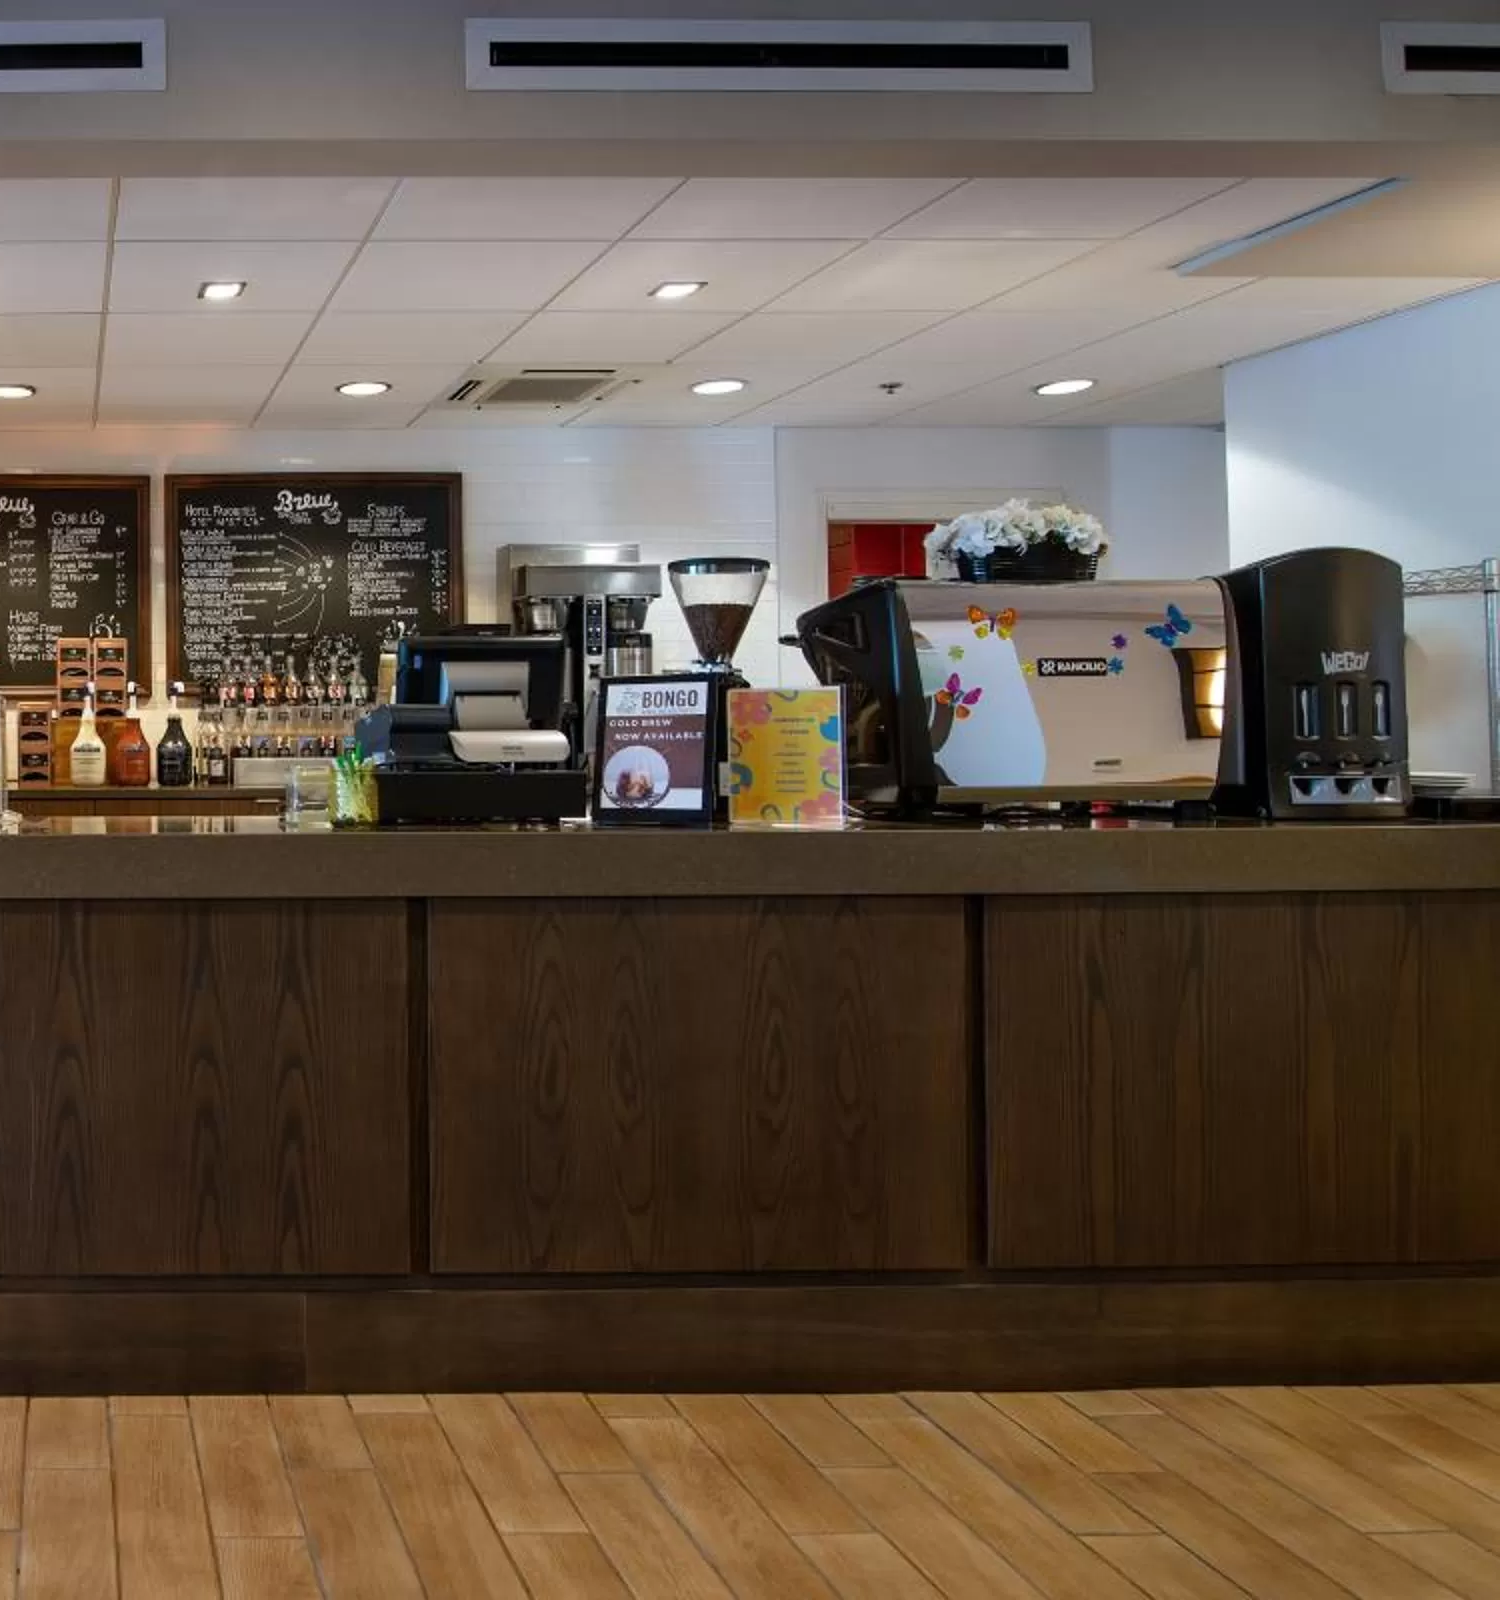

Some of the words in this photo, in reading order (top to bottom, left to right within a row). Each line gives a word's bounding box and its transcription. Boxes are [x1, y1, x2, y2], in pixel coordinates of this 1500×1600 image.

[642, 689, 698, 708] BONGO
[609, 719, 638, 727] COLD
[641, 718, 672, 728] BREW
[614, 732, 640, 741] NOW
[643, 731, 704, 741] AVAILABLE
